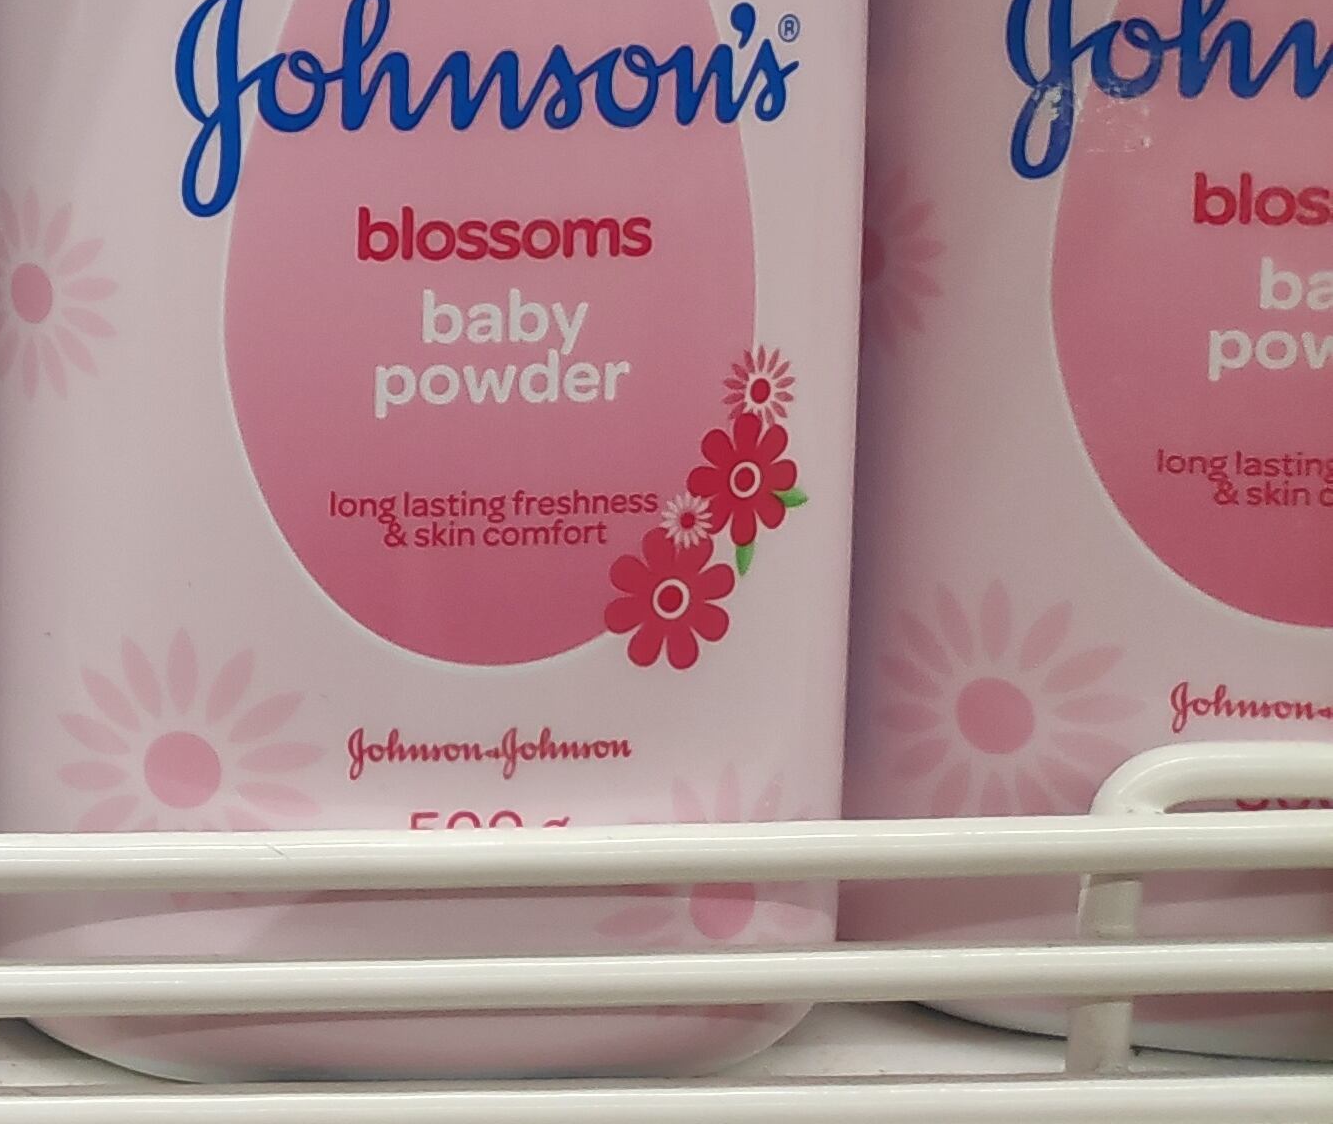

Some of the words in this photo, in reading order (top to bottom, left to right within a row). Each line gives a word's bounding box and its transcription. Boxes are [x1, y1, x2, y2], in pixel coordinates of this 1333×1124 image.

[357, 205, 653, 262] blossoms
[422, 288, 588, 355] baby
[373, 350, 631, 419] powder
[1155, 448, 1228, 482] long
[329, 490, 397, 526] long
[402, 490, 505, 524] lasting
[512, 488, 658, 516] freshness
[1213, 480, 1239, 506] &
[1246, 480, 1311, 507] skin
[384, 521, 408, 548] &
[414, 520, 476, 548] skin
[482, 518, 608, 547] comfort
